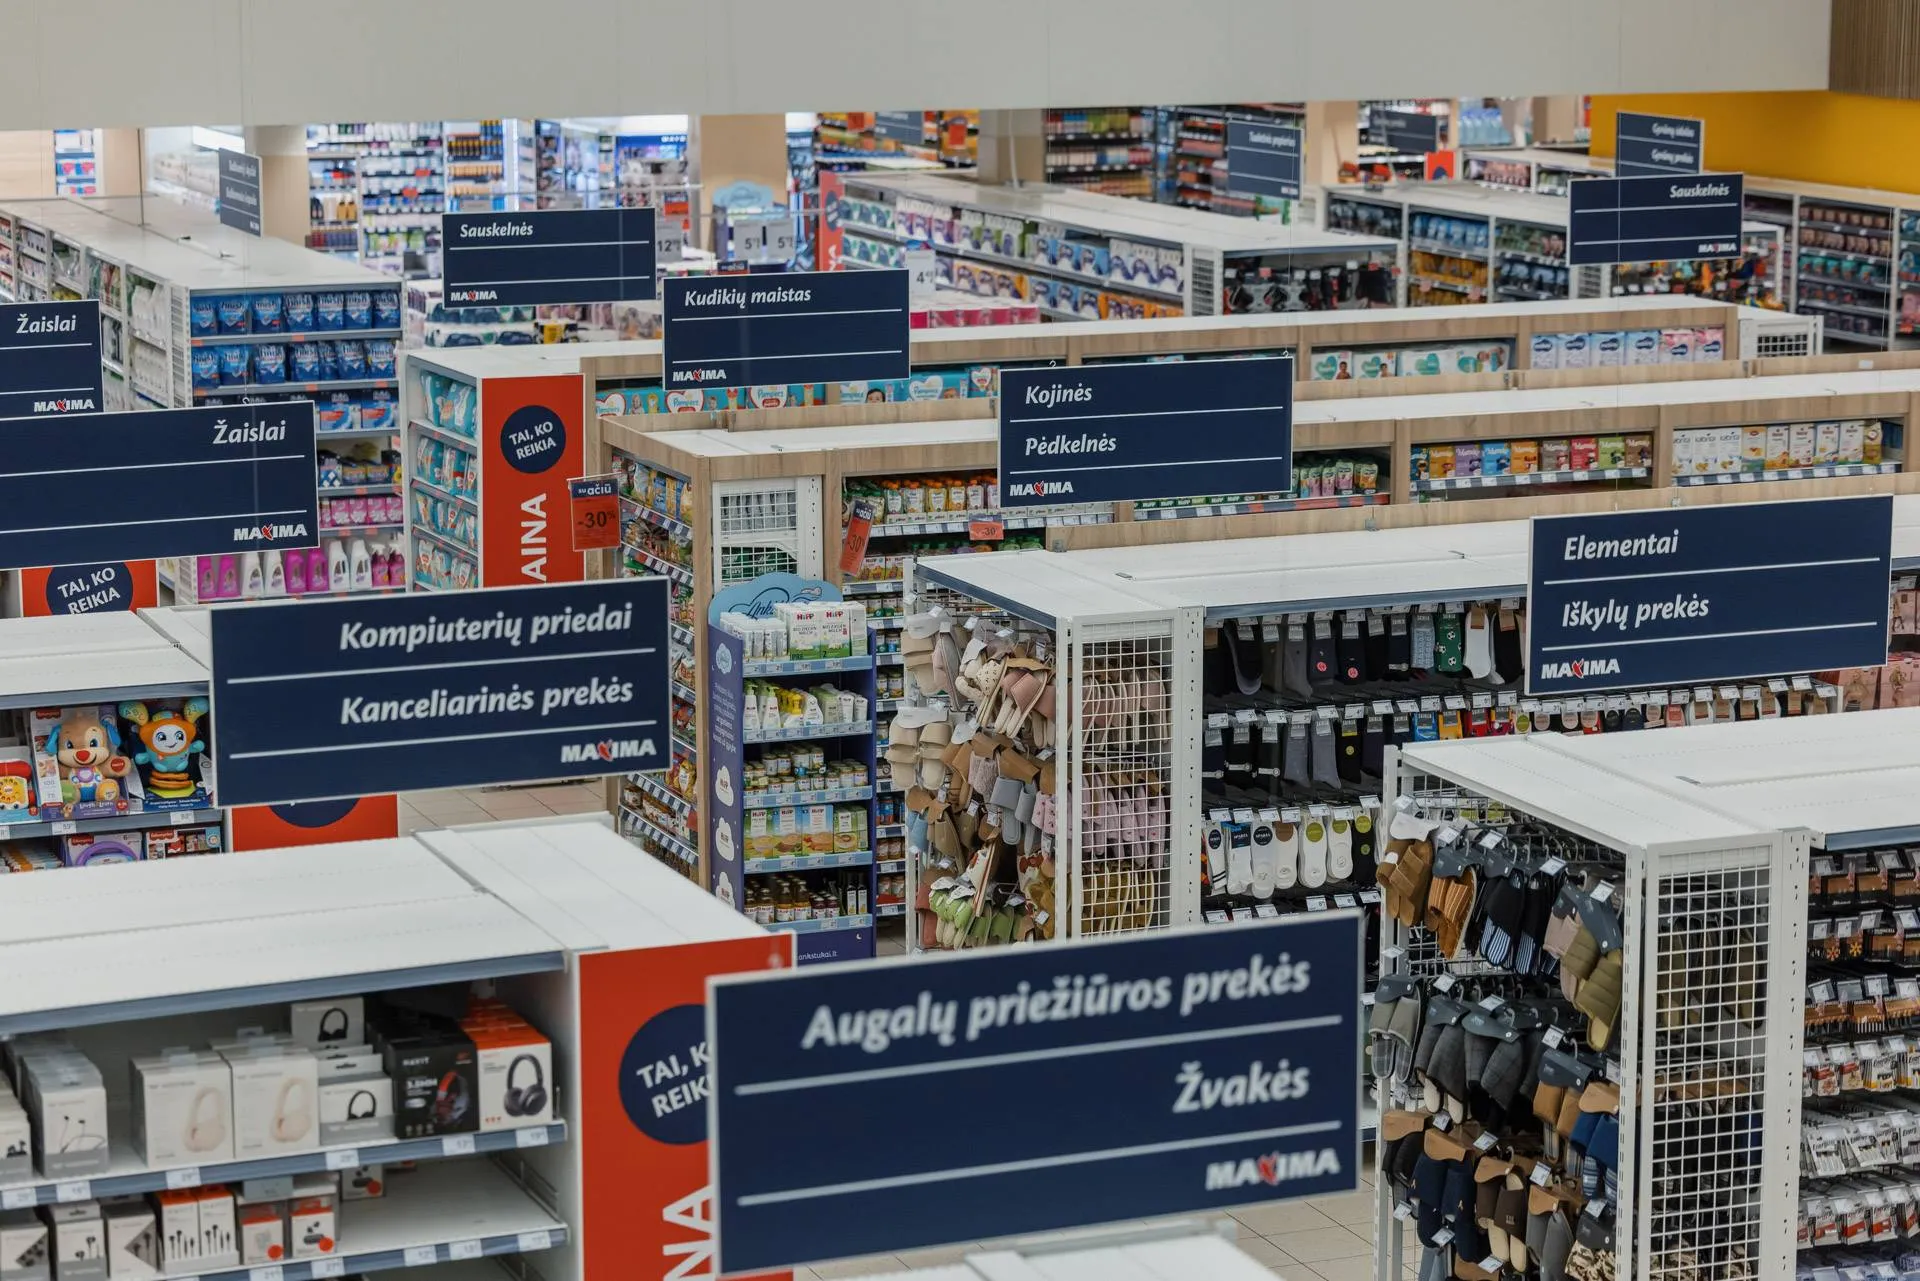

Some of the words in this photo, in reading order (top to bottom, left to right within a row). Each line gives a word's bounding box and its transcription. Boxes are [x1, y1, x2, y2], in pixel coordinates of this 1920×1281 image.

[1669, 183, 1730, 199] Sauskelnės
[460, 222, 533, 238] Sauskelnės
[450, 290, 497, 301] MAXIMA
[684, 288, 746, 309] Kudikių
[751, 287, 811, 304] maistas
[16, 313, 76, 333] Žaislai
[672, 368, 727, 382] MAXIMA
[34, 398, 95, 412] MAXIMA
[1025, 382, 1092, 408] Kojinės
[213, 419, 286, 444] Žaislai
[509, 429, 534, 446] TAI,
[534, 421, 554, 437] KO
[515, 436, 557, 460] REIKIA
[1025, 433, 1117, 456] Pėdkelnės
[587, 483, 611, 496] ačiū
[1009, 480, 1074, 496] MAXIMA
[233, 523, 308, 541] MAXIMA
[520, 493, 547, 581] AINA
[1564, 528, 1679, 561] Elementai
[57, 578, 90, 598] TAI,
[91, 567, 115, 586] KO
[67, 587, 121, 615] REIKIA
[1562, 599, 1629, 632] Iškylų
[1634, 593, 1709, 629] prekės
[340, 611, 523, 653] Kompiuterių
[530, 602, 632, 643] priedai
[1541, 658, 1621, 680] MAXIMA
[341, 683, 534, 725] Kanceliarinės
[541, 676, 633, 716] prekės
[561, 739, 657, 763] MAXIMA
[802, 991, 957, 1054] Augalų
[967, 974, 1172, 1041] priežiūros
[1180, 952, 1311, 1017] prekės
[636, 1055, 688, 1089] TAI,
[690, 1040, 711, 1068] K
[1172, 1059, 1309, 1114] Žvakės
[1206, 1148, 1340, 1191] MAXIMA
